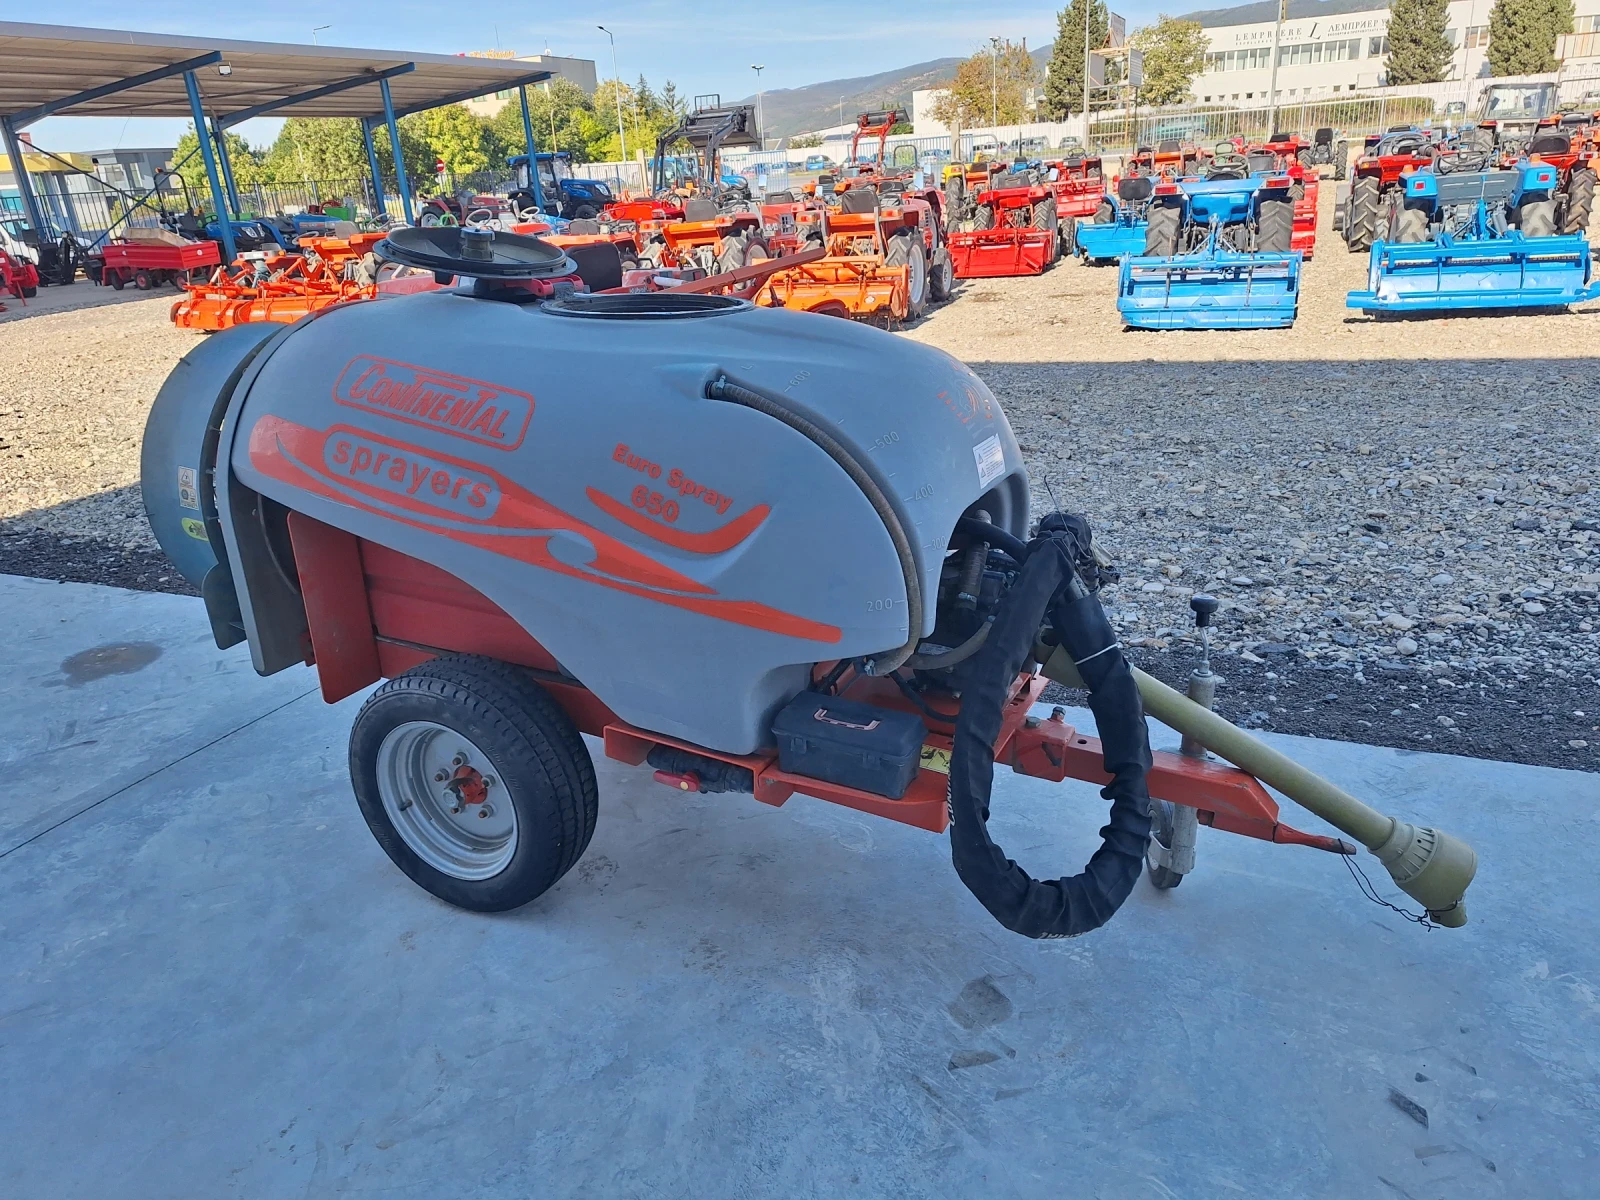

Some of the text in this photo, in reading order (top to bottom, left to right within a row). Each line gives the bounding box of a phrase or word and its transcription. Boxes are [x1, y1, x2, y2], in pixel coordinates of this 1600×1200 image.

[789, 370, 811, 387] 600
[875, 431, 900, 450] 500
[333, 440, 491, 508] sprayers
[612, 442, 733, 515] Euro Spray
[914, 483, 935, 501] 400
[631, 484, 680, 523] 650
[931, 535, 947, 550] 300
[867, 598, 893, 612] 200
